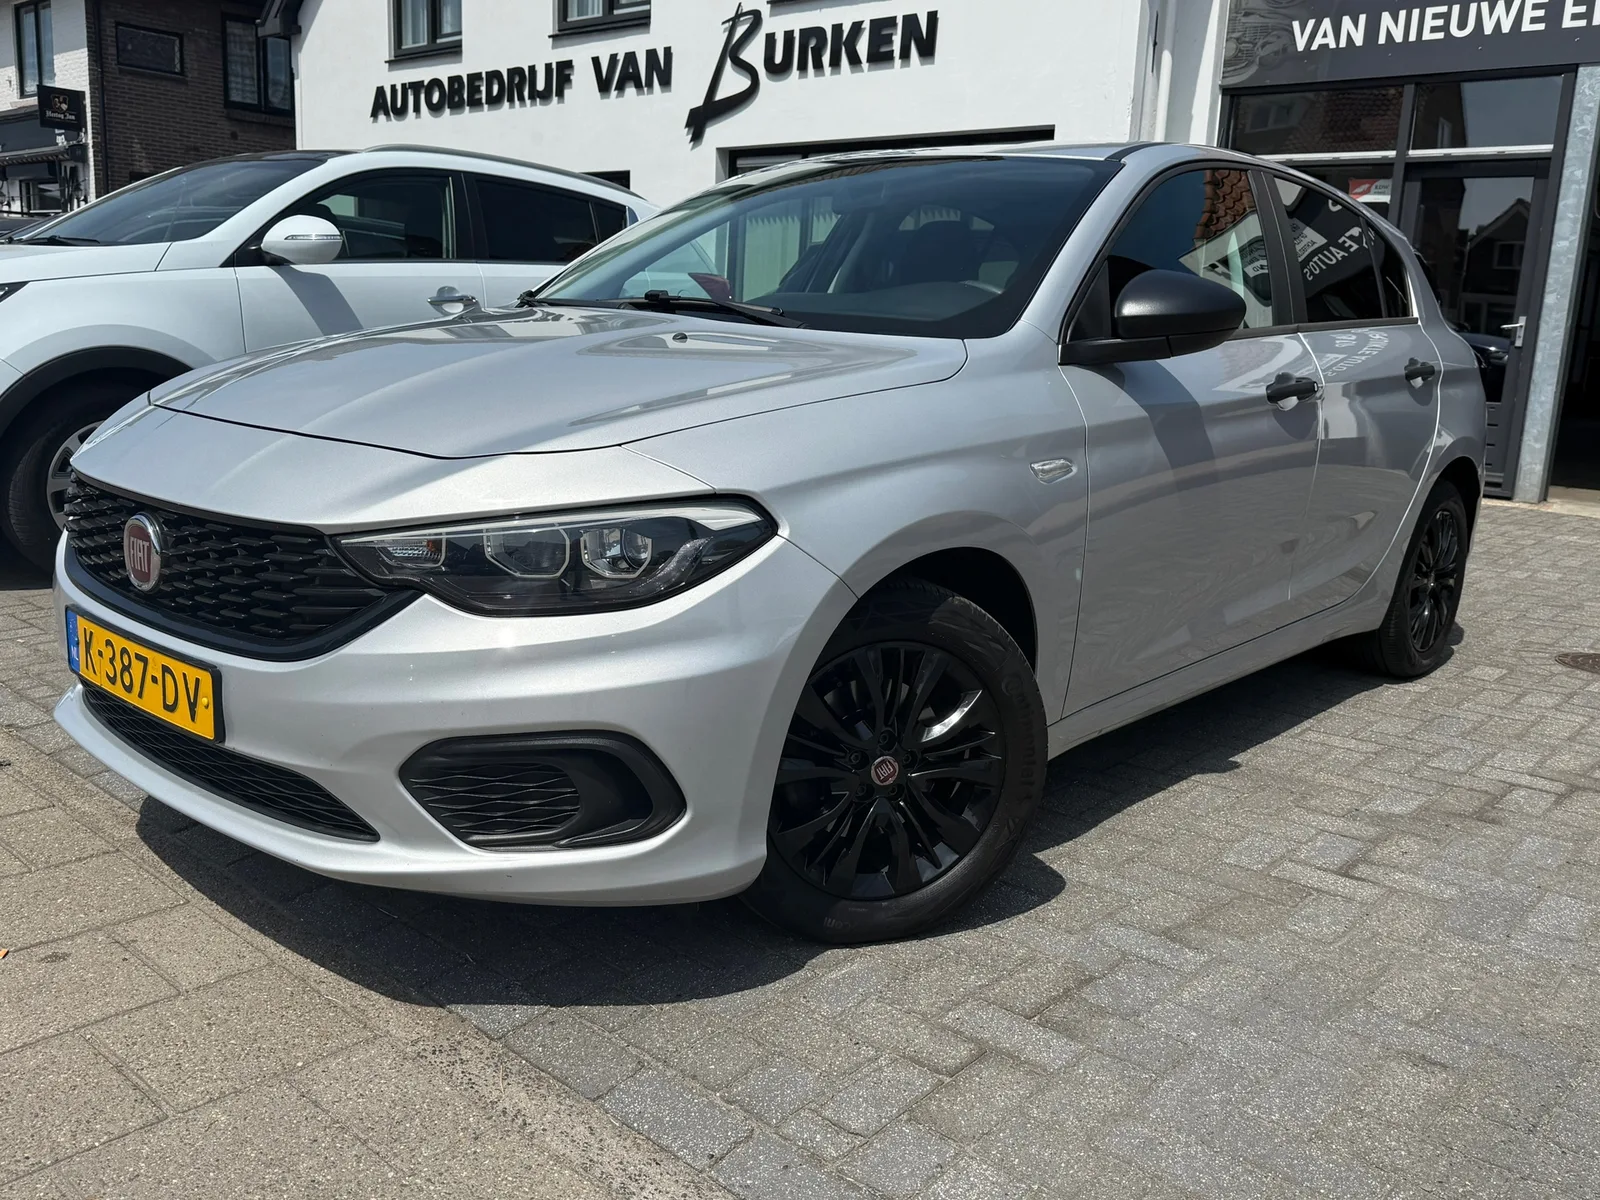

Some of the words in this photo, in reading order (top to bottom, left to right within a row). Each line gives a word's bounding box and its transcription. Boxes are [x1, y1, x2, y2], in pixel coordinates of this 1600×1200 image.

[1292, 14, 1367, 52] VAN
[1378, 0, 1549, 45] NIEUWE
[370, 59, 574, 119] AUTOBEDRIJF
[591, 46, 672, 93] VAN
[685, 2, 939, 144] BURKEN
[130, 536, 150, 573] FIAT
[83, 626, 201, 723] K-387-DV
[876, 761, 894, 780] FIAT
